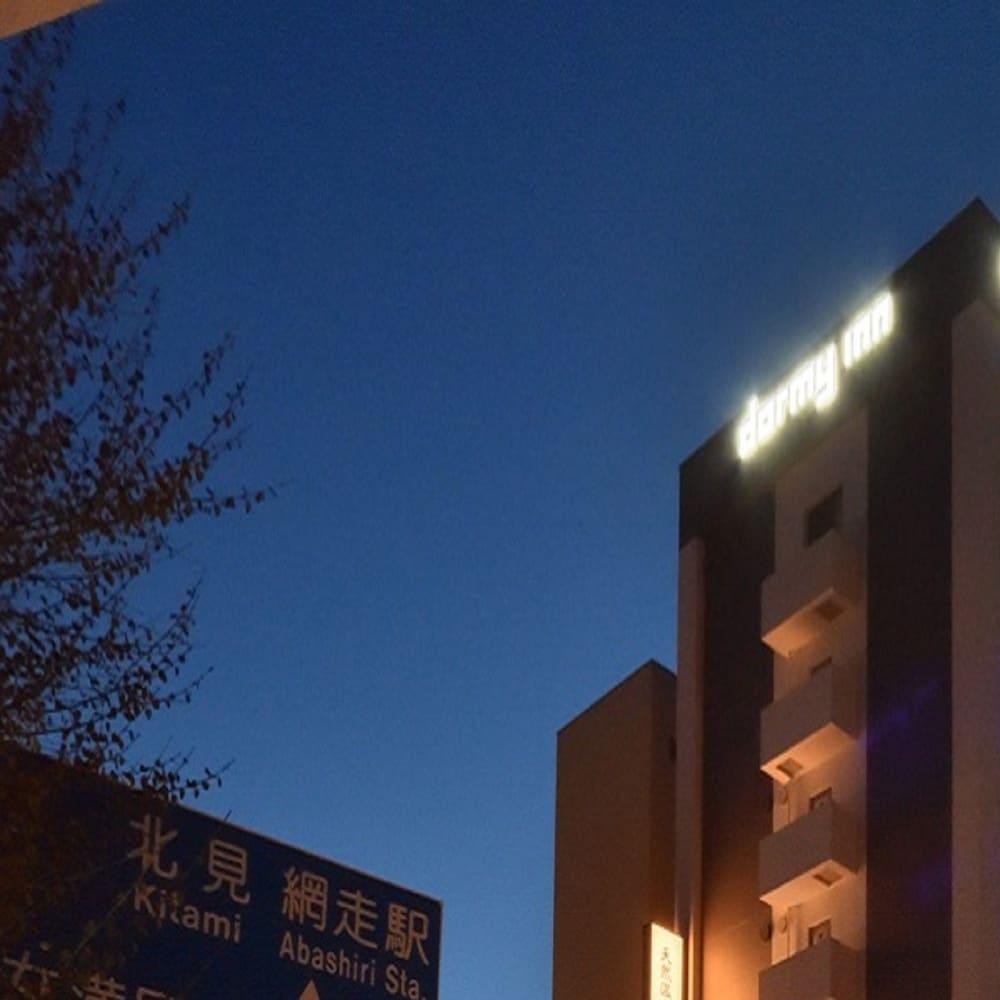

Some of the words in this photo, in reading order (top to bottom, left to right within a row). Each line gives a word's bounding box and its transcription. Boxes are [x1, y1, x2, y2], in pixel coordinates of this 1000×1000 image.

[736, 342, 840, 460] dormy
[842, 292, 895, 369] inn
[129, 811, 251, 906] 北見
[133, 886, 242, 945] Kitami
[279, 864, 430, 967] 網走駅
[279, 932, 377, 987] Abashiri
